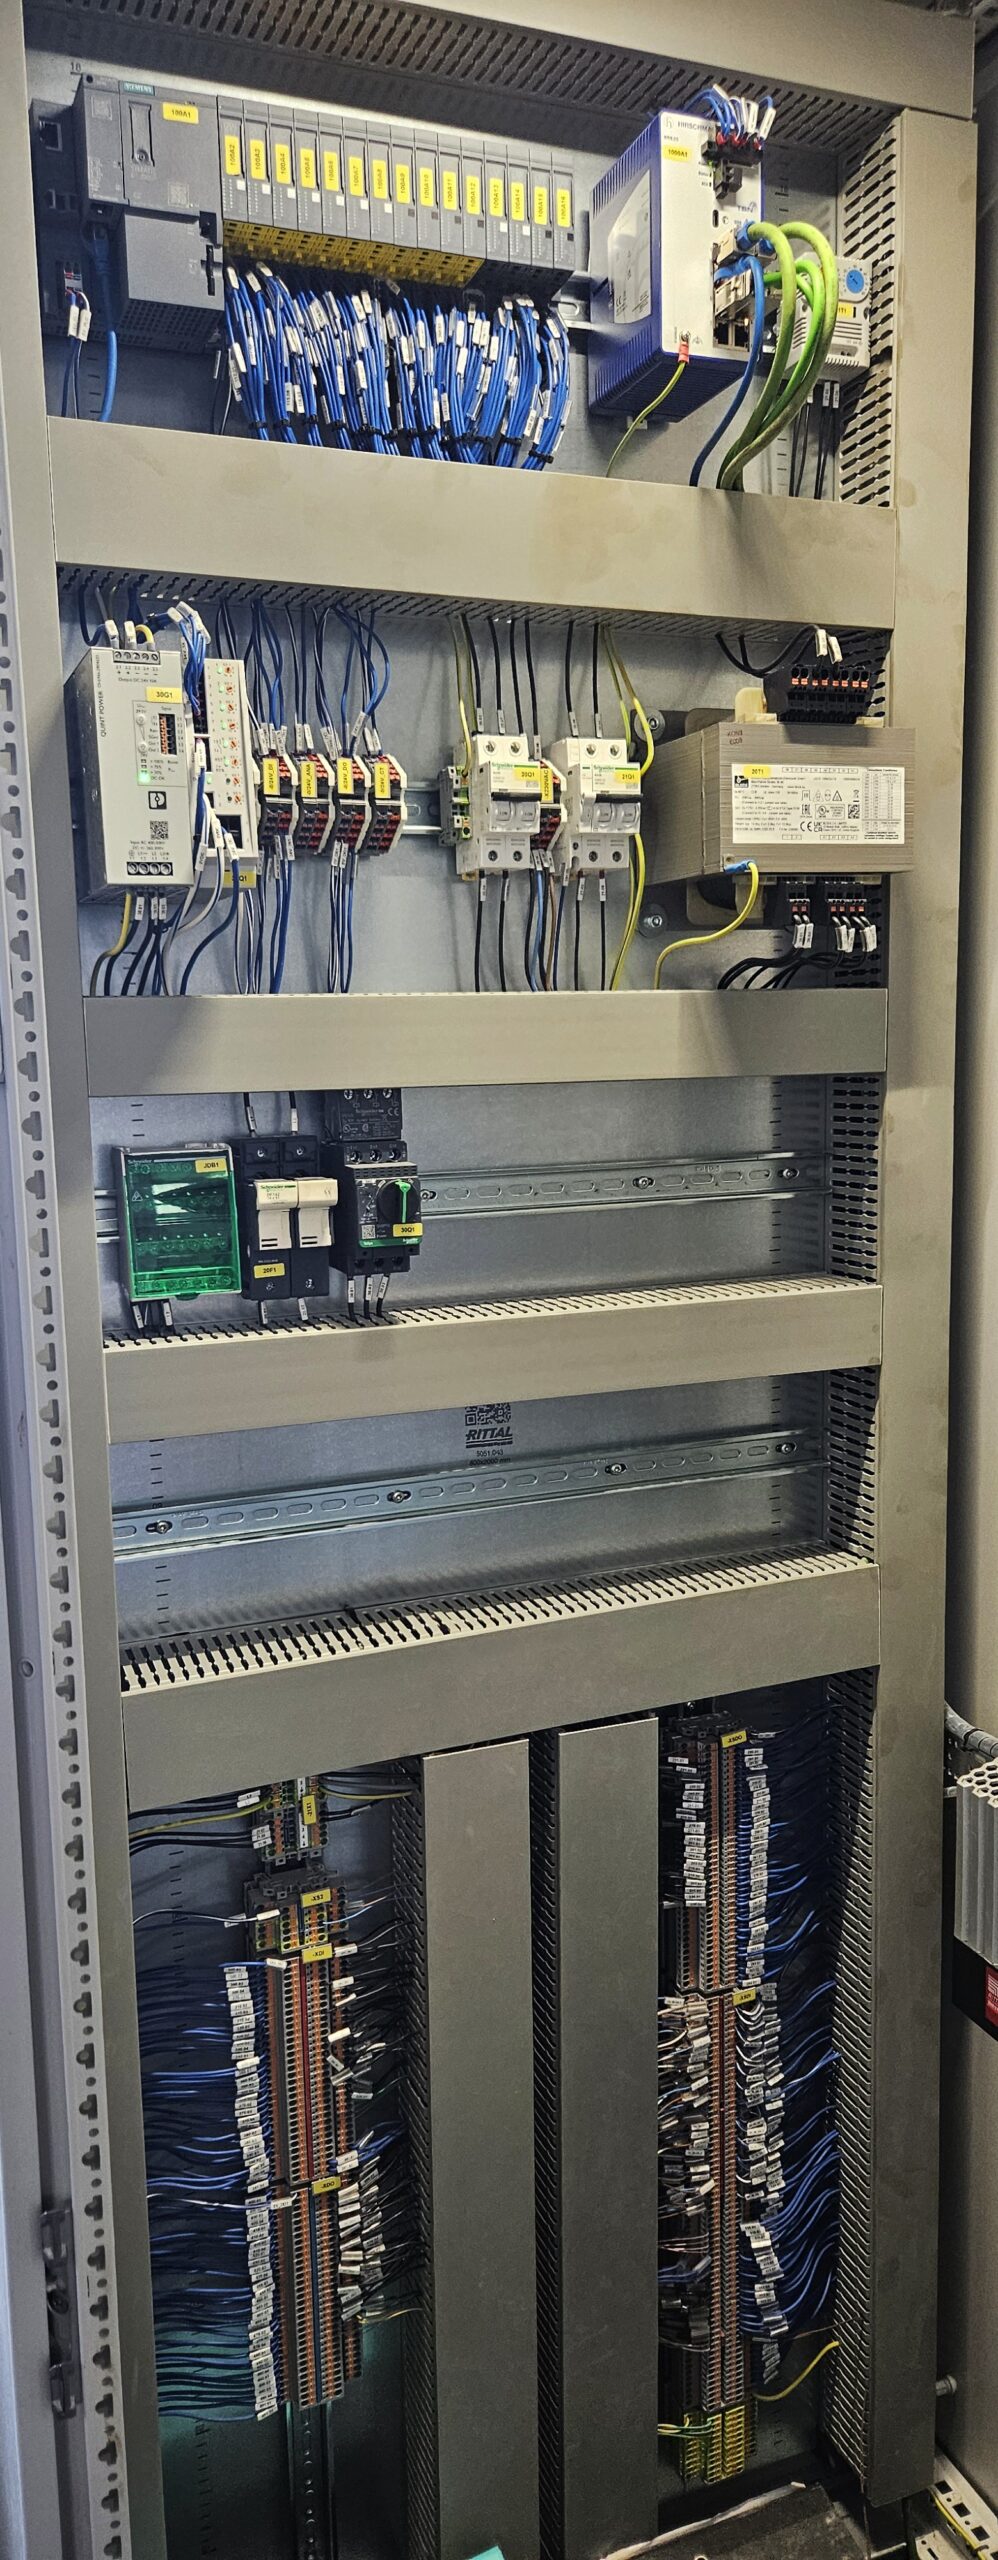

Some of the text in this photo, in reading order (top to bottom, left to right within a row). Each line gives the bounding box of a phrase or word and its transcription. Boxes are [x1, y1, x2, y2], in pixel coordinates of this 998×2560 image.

[171, 108, 191, 118] 100A1
[668, 149, 688, 158] 1000A1
[465, 1426, 513, 1440] RITTAL
